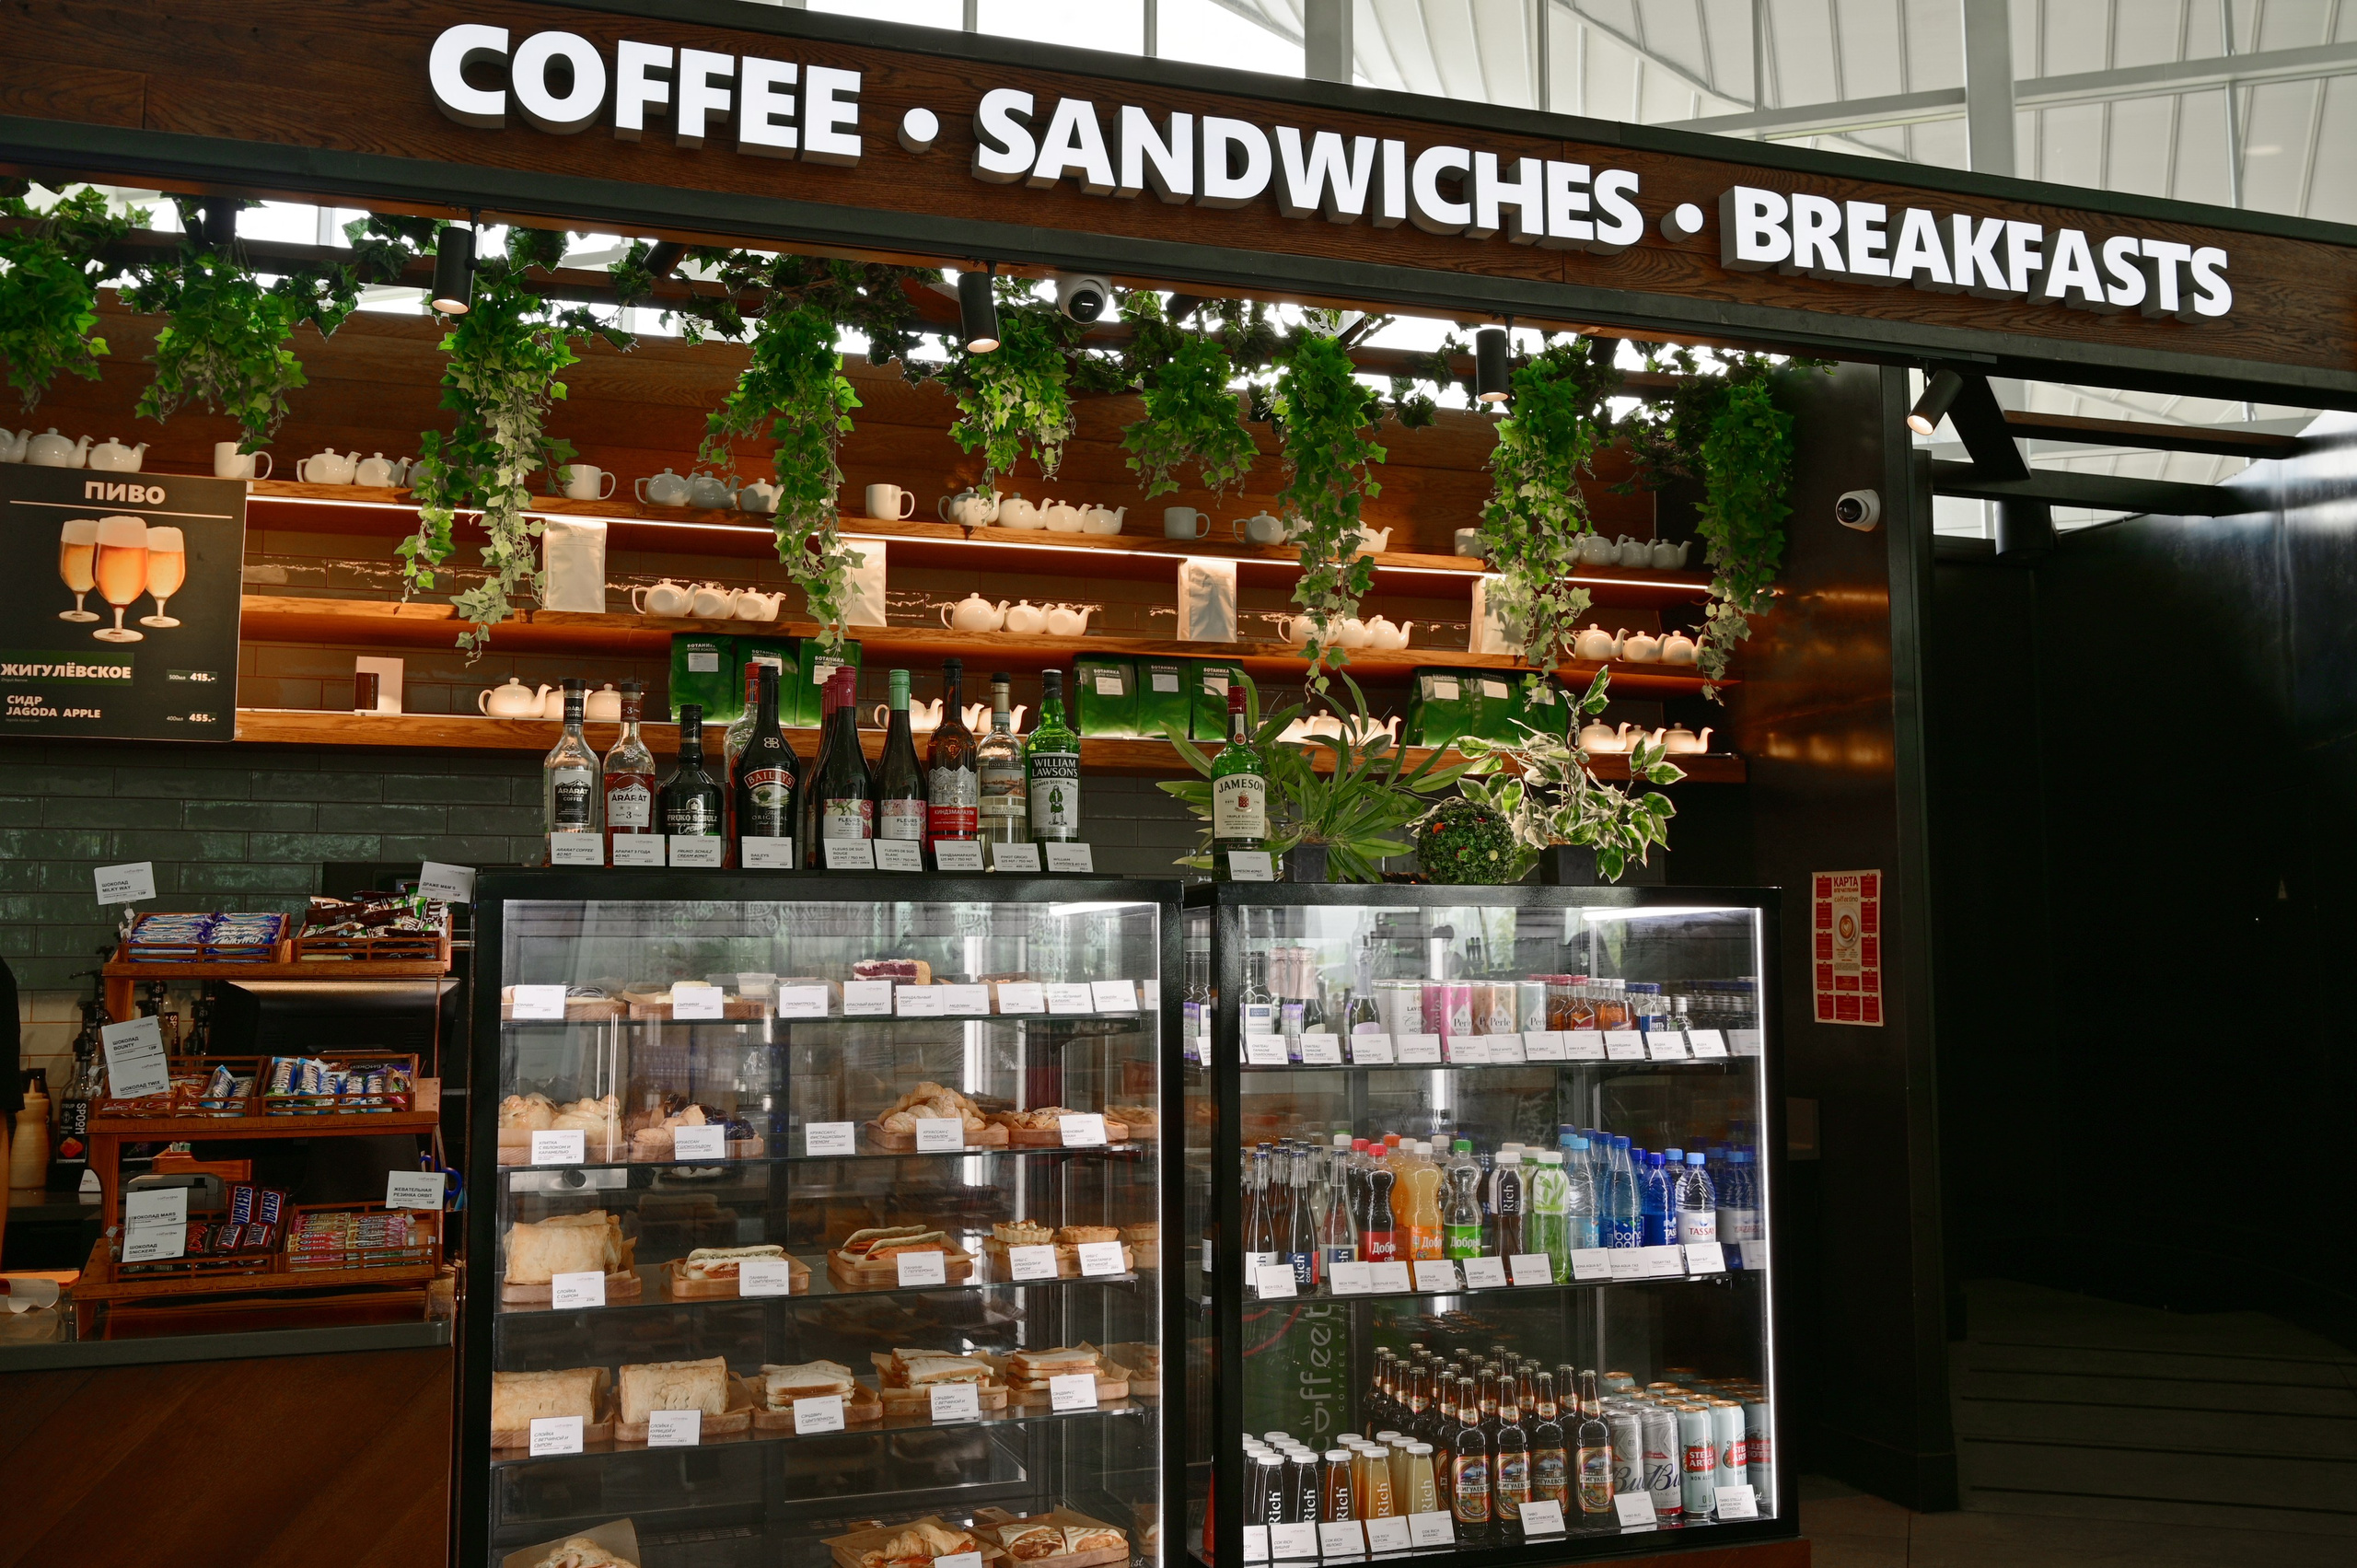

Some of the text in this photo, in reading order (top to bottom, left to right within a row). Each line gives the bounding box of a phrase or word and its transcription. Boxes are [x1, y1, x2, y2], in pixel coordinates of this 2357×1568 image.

[429, 23, 2233, 318] COFFEE SANDWICHES BREAKFASTS
[84, 481, 166, 505] ПИВО
[1, 662, 132, 679] ЖИГУЛЁВСКОЕ
[6, 694, 43, 706] СИДР
[6, 706, 58, 717] JAGODA
[63, 707, 102, 719] APPLE
[627, 705, 633, 714] 3
[1033, 759, 1076, 769] WILLIAM
[748, 771, 793, 785] BAILEYS
[557, 786, 589, 796] ARARAT
[1218, 778, 1264, 794] JAMESON
[611, 793, 647, 803] ARARAT
[626, 810, 633, 819] 3
[667, 814, 691, 822] FRUKO
[1833, 876, 1859, 888] КАРТА
[1490, 1016, 1512, 1027] Perle
[111, 1036, 140, 1046] ШОКОЛАД
[112, 1042, 135, 1051] BOUNTY
[119, 1081, 147, 1093] ШОКОЛАД
[1503, 1184, 1515, 1214] Rich
[1376, 1481, 1391, 1518] Rich
[1421, 1478, 1434, 1514] Rich
[1268, 1489, 1282, 1526] Rich
[1303, 1487, 1317, 1524] Rich
[1334, 1486, 1349, 1522] Rich
